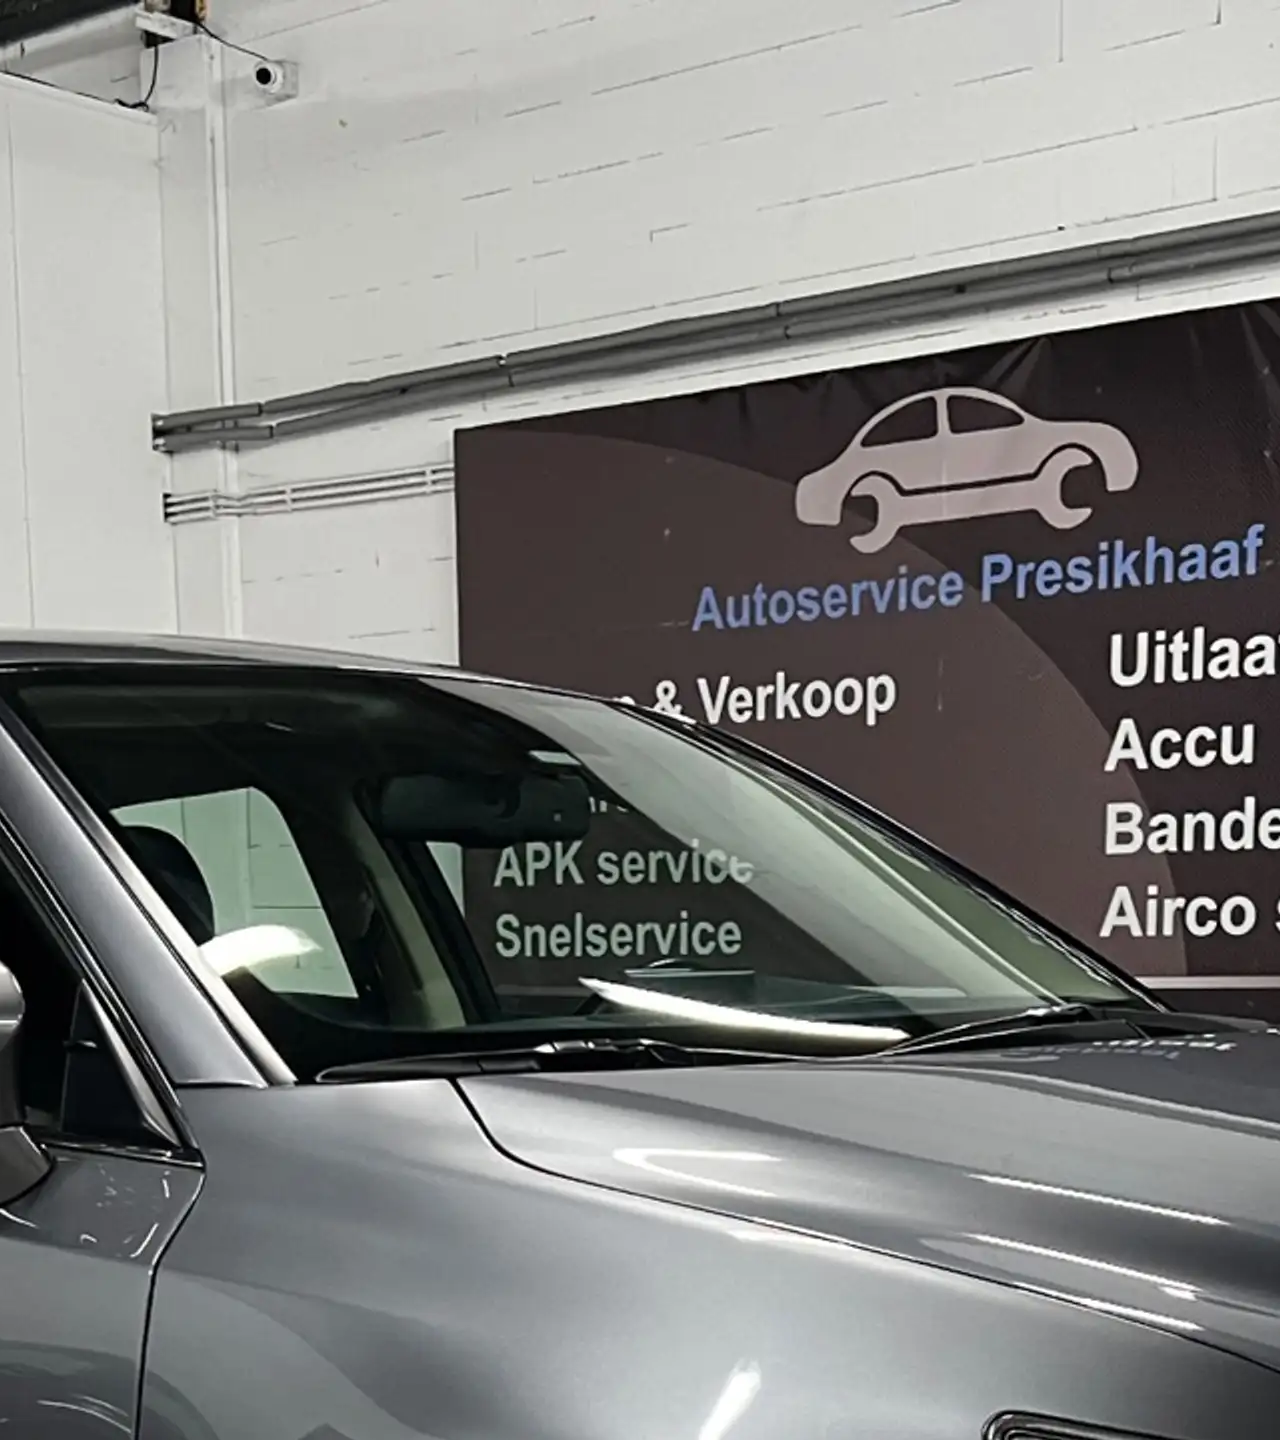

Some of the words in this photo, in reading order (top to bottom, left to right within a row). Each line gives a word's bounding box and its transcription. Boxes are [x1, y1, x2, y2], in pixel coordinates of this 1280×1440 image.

[692, 566, 963, 631] Autoservice
[981, 524, 1265, 602] Presikhaaf
[654, 680, 683, 715] &
[697, 671, 896, 725] Verkoop
[1104, 718, 1255, 772] Accu
[494, 840, 583, 887] APK
[495, 911, 741, 957] Snelservice
[1099, 885, 1256, 937] Airco
